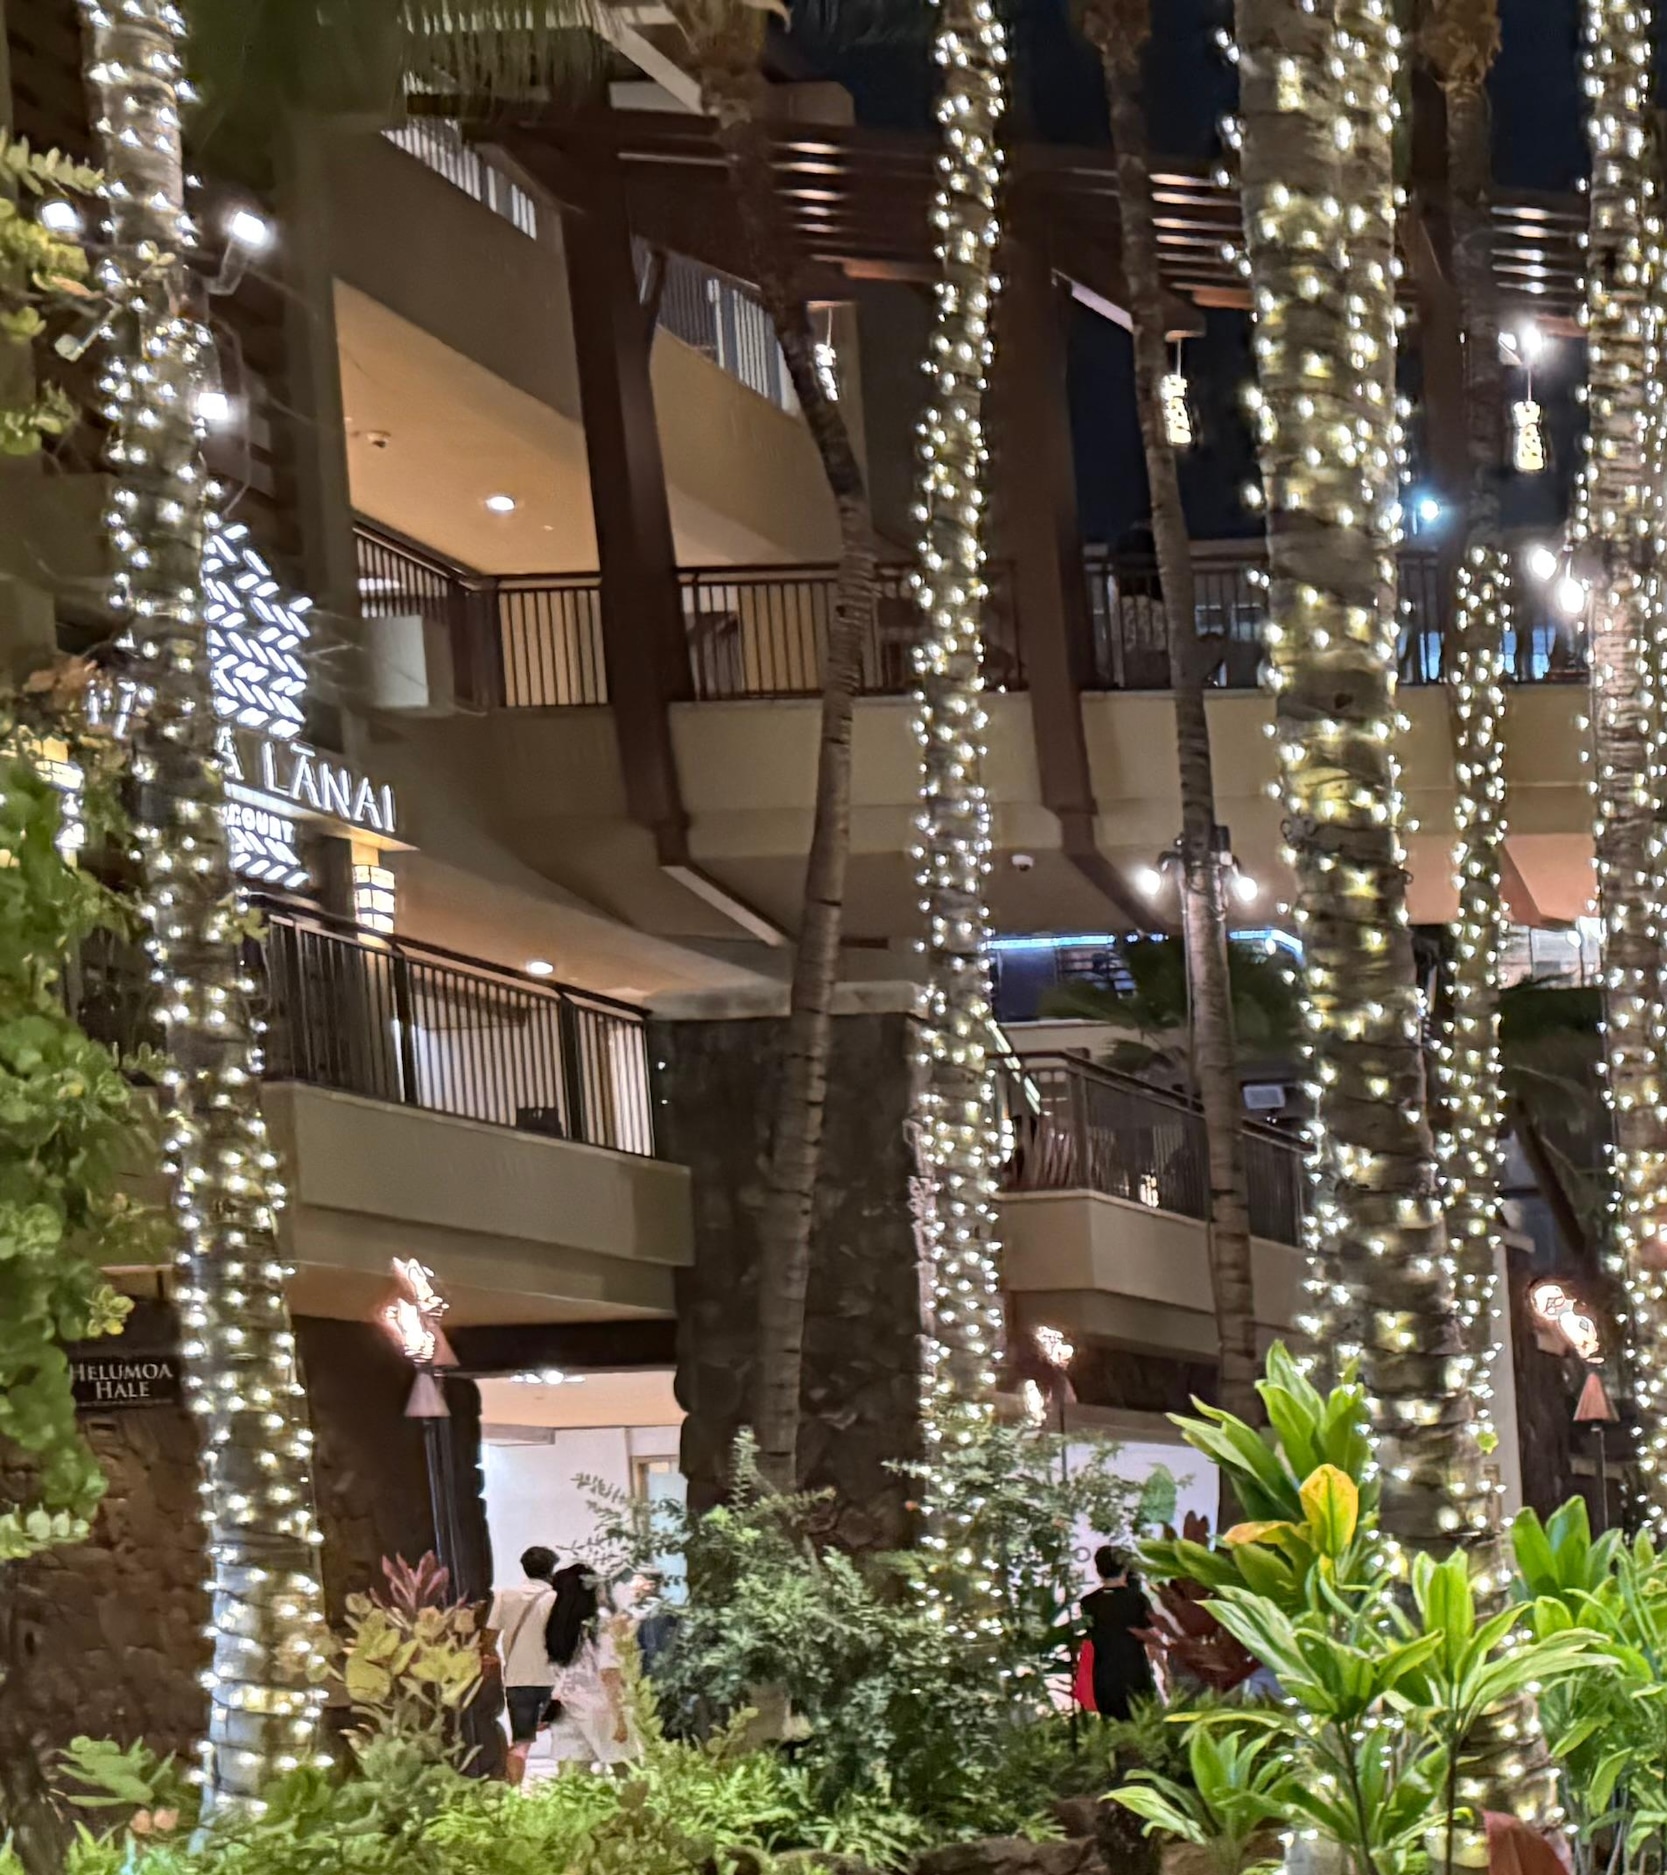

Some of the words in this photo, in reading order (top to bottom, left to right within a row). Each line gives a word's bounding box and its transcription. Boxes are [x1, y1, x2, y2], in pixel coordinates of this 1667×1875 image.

[225, 802, 296, 844] COURT
[69, 1362, 174, 1382] HELUMOA
[96, 1380, 151, 1399] HALE
